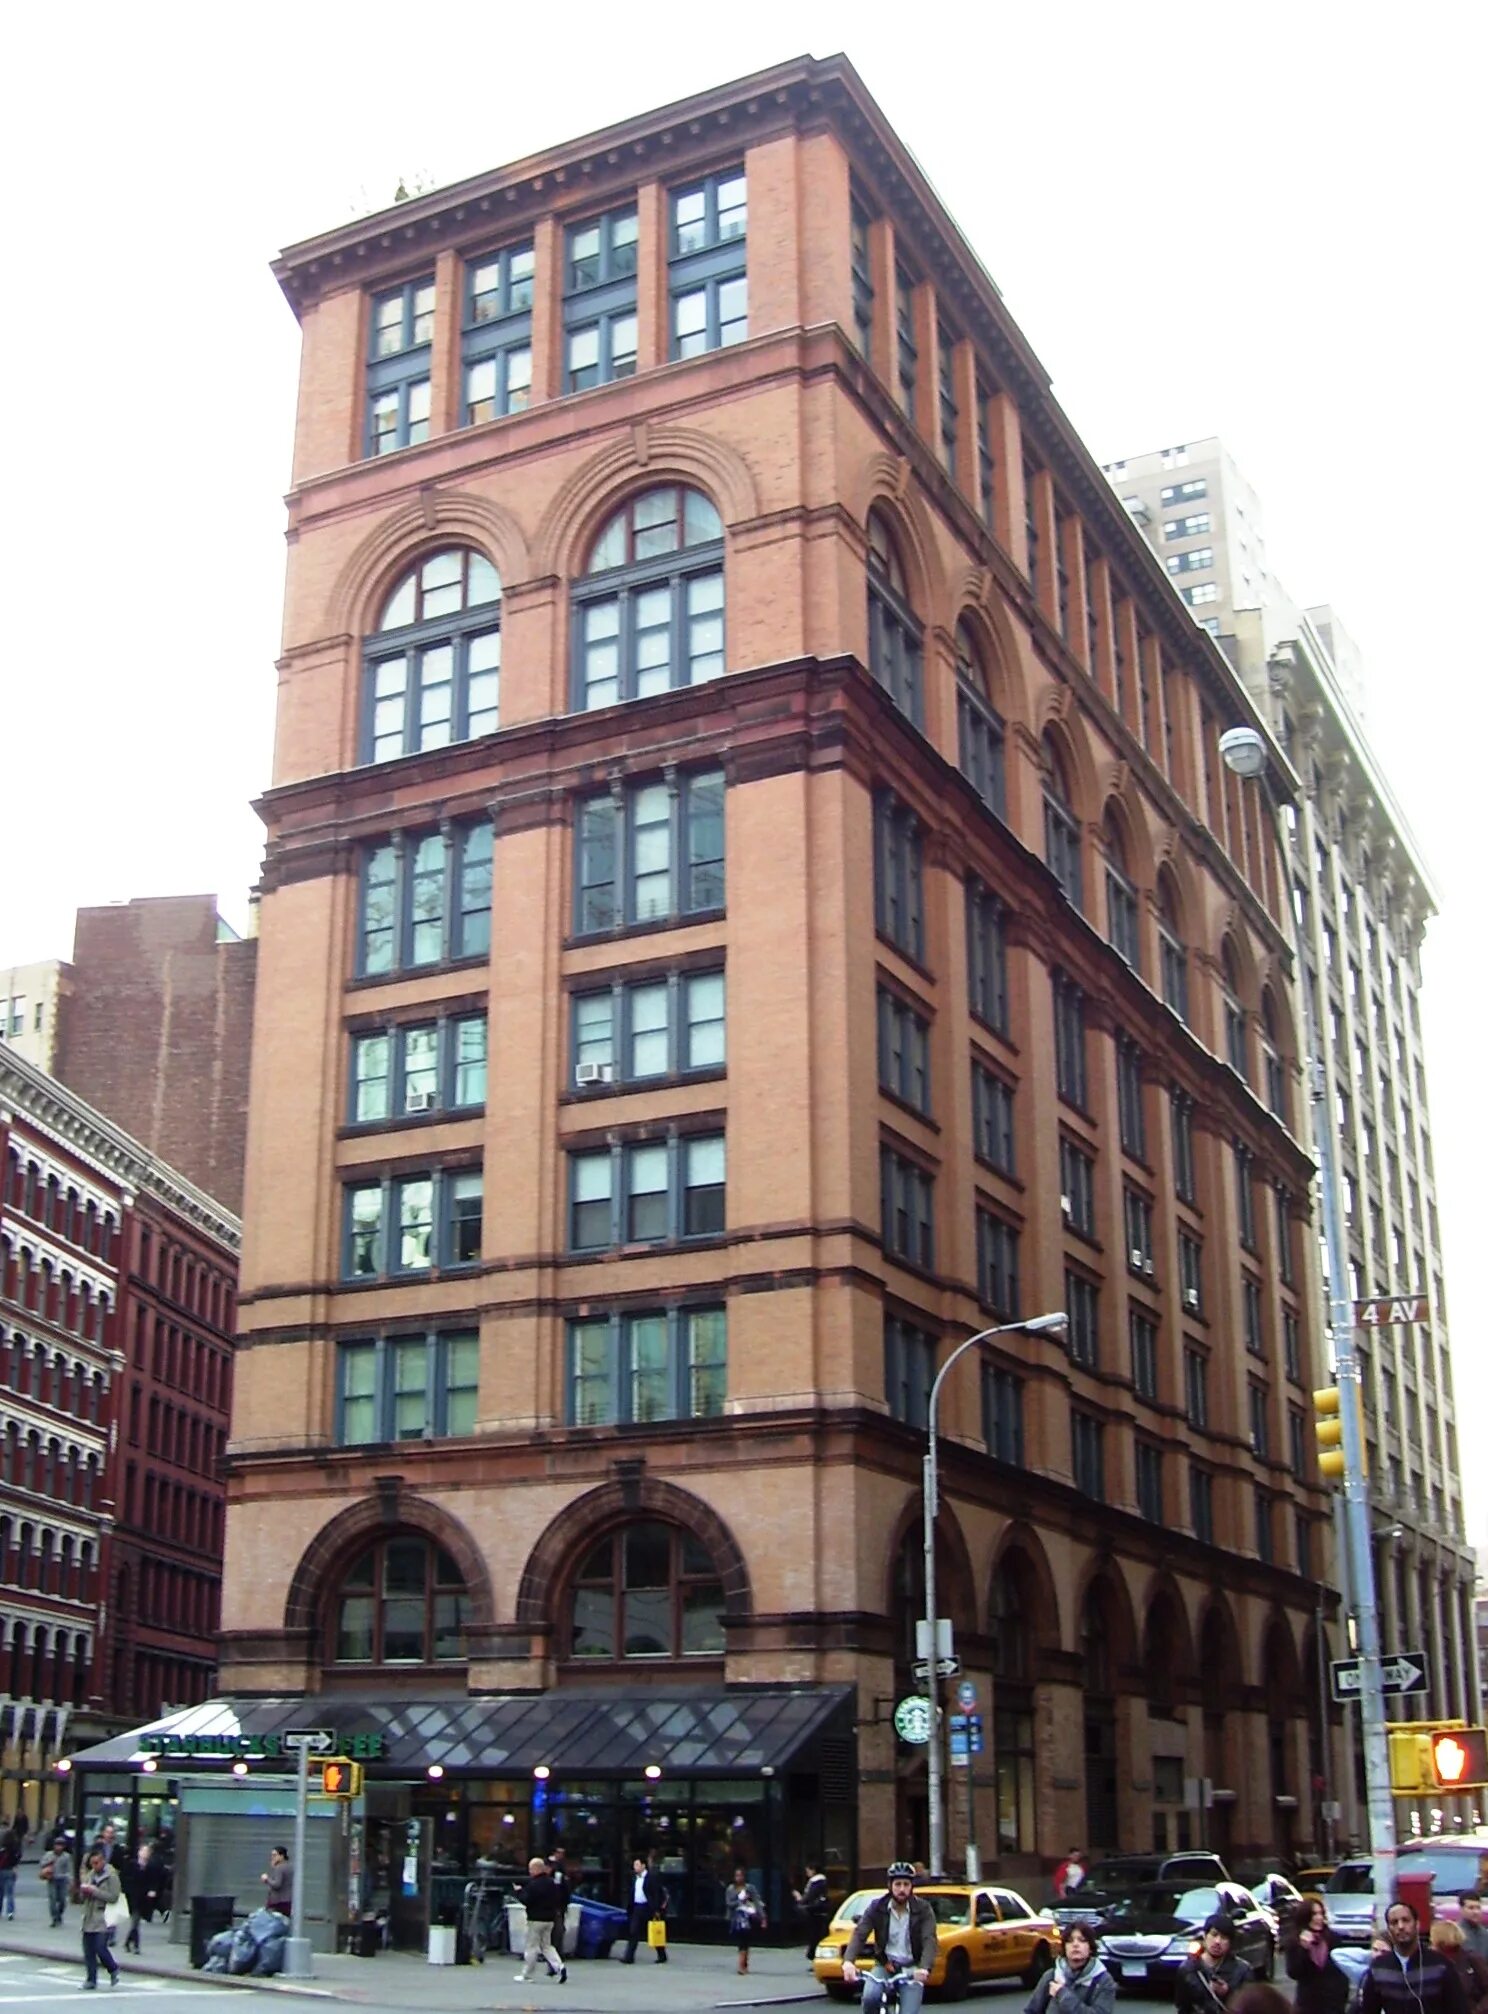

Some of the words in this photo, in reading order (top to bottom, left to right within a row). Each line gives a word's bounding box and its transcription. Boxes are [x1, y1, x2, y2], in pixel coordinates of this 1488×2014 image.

[1361, 1303, 1379, 1323] 4
[1388, 1300, 1419, 1322] AV
[138, 1733, 282, 1757] STARBUCKS
